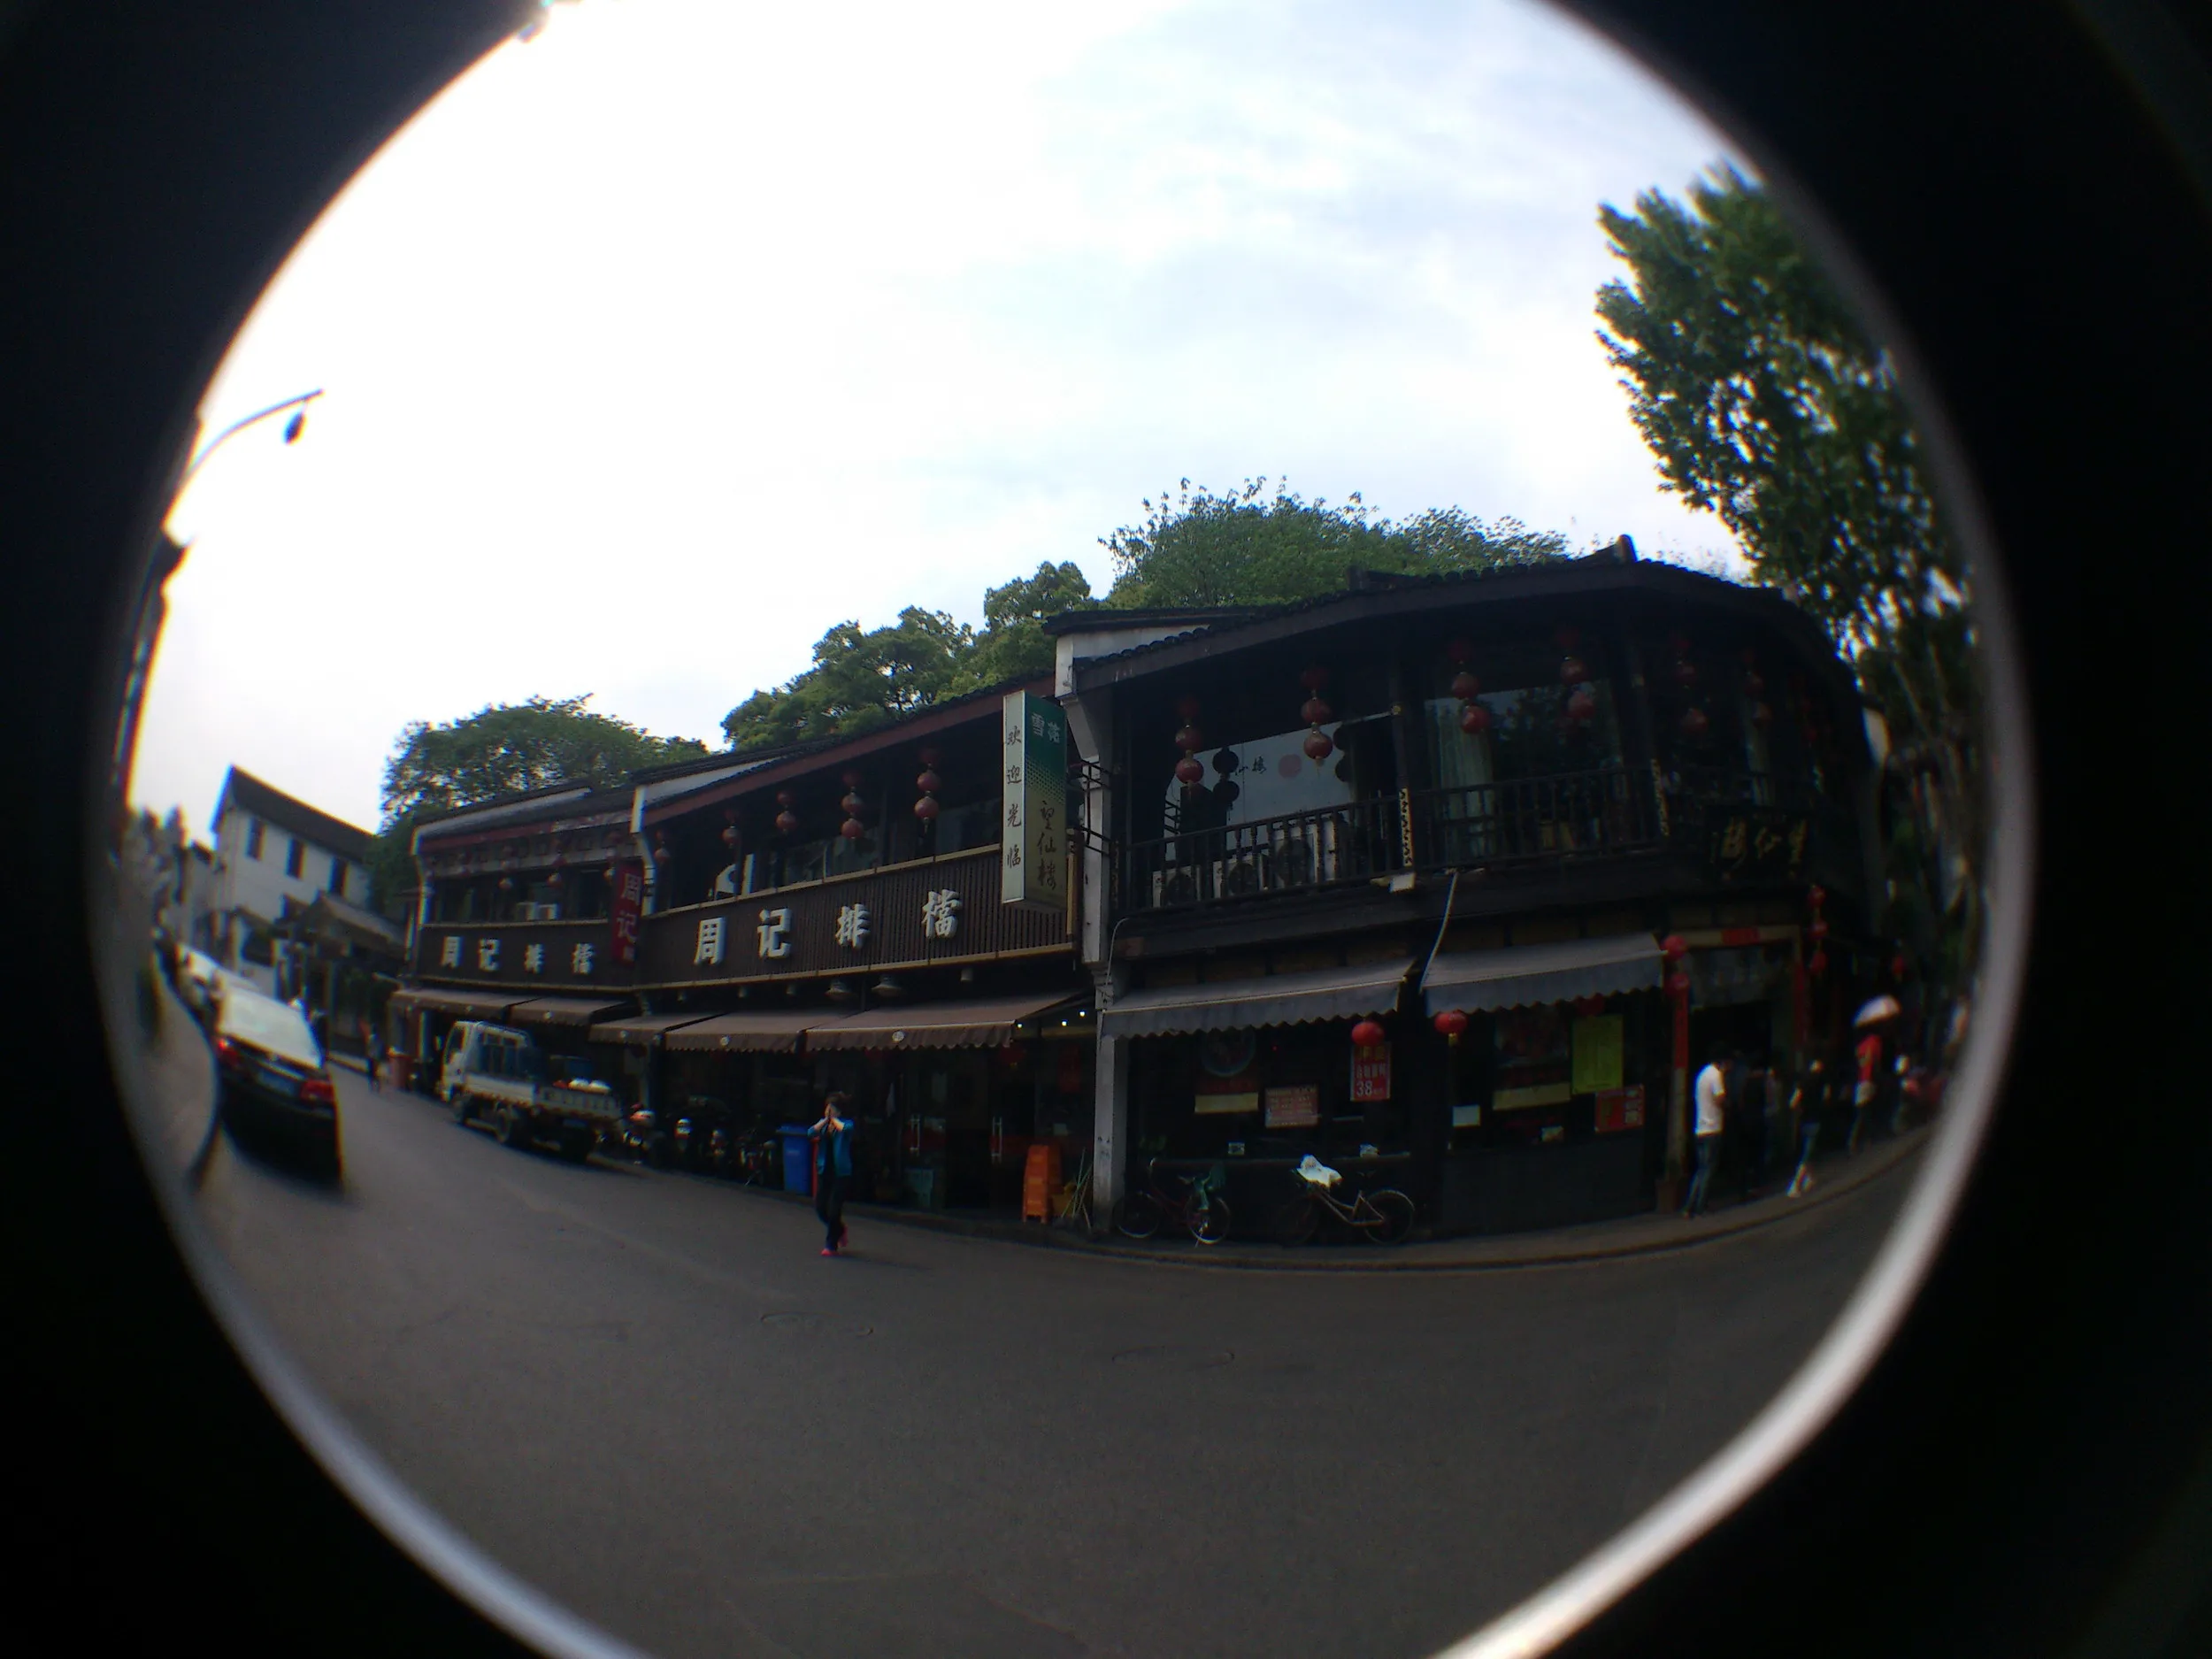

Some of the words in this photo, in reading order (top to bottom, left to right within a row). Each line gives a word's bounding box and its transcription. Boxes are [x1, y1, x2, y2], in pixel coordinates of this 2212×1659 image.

[1031, 711, 1061, 744] 雪花
[1007, 726, 1022, 868] 欢迎光临
[617, 872, 642, 943] 周记
[1356, 1080, 1372, 1097] 38
